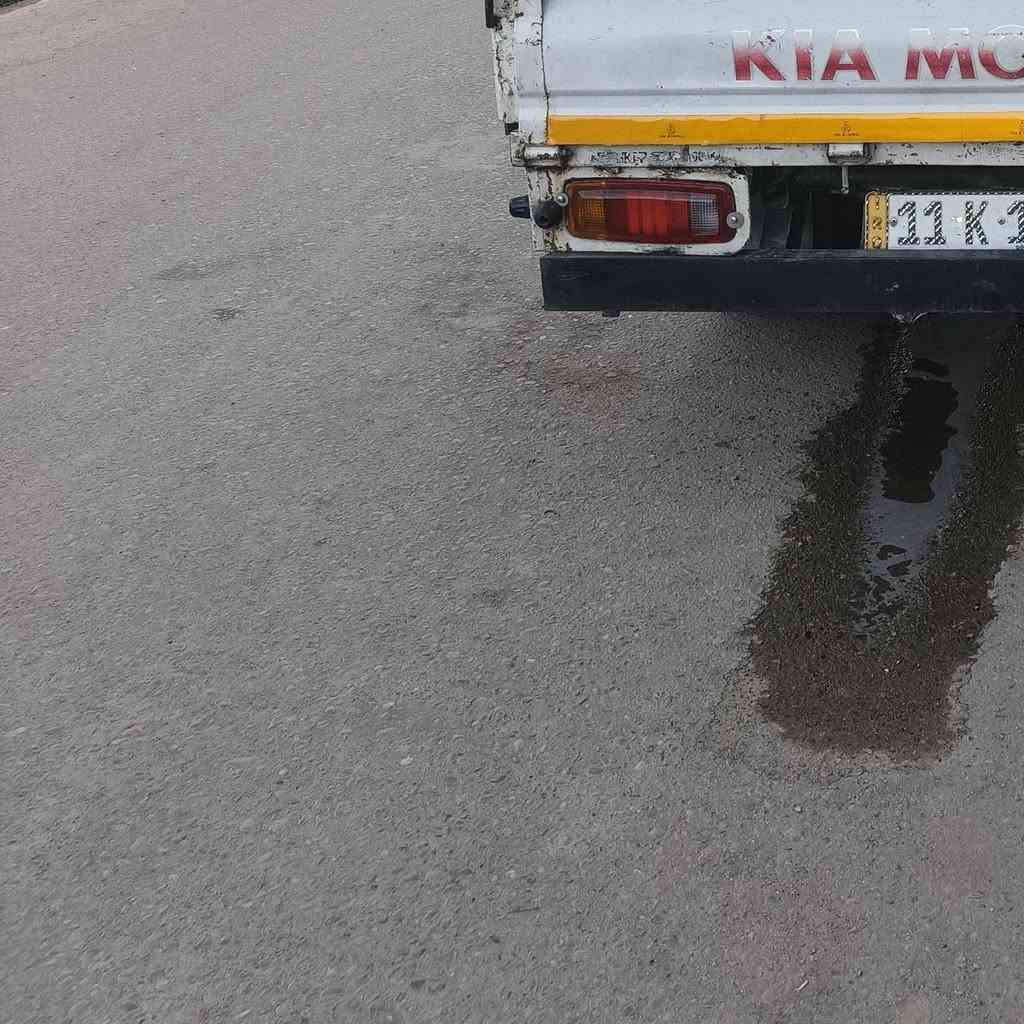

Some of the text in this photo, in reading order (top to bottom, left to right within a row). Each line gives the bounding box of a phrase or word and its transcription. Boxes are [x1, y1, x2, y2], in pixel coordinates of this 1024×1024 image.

[730, 27, 880, 81] KIA
[897, 199, 948, 245] 11
[964, 200, 989, 245] K
